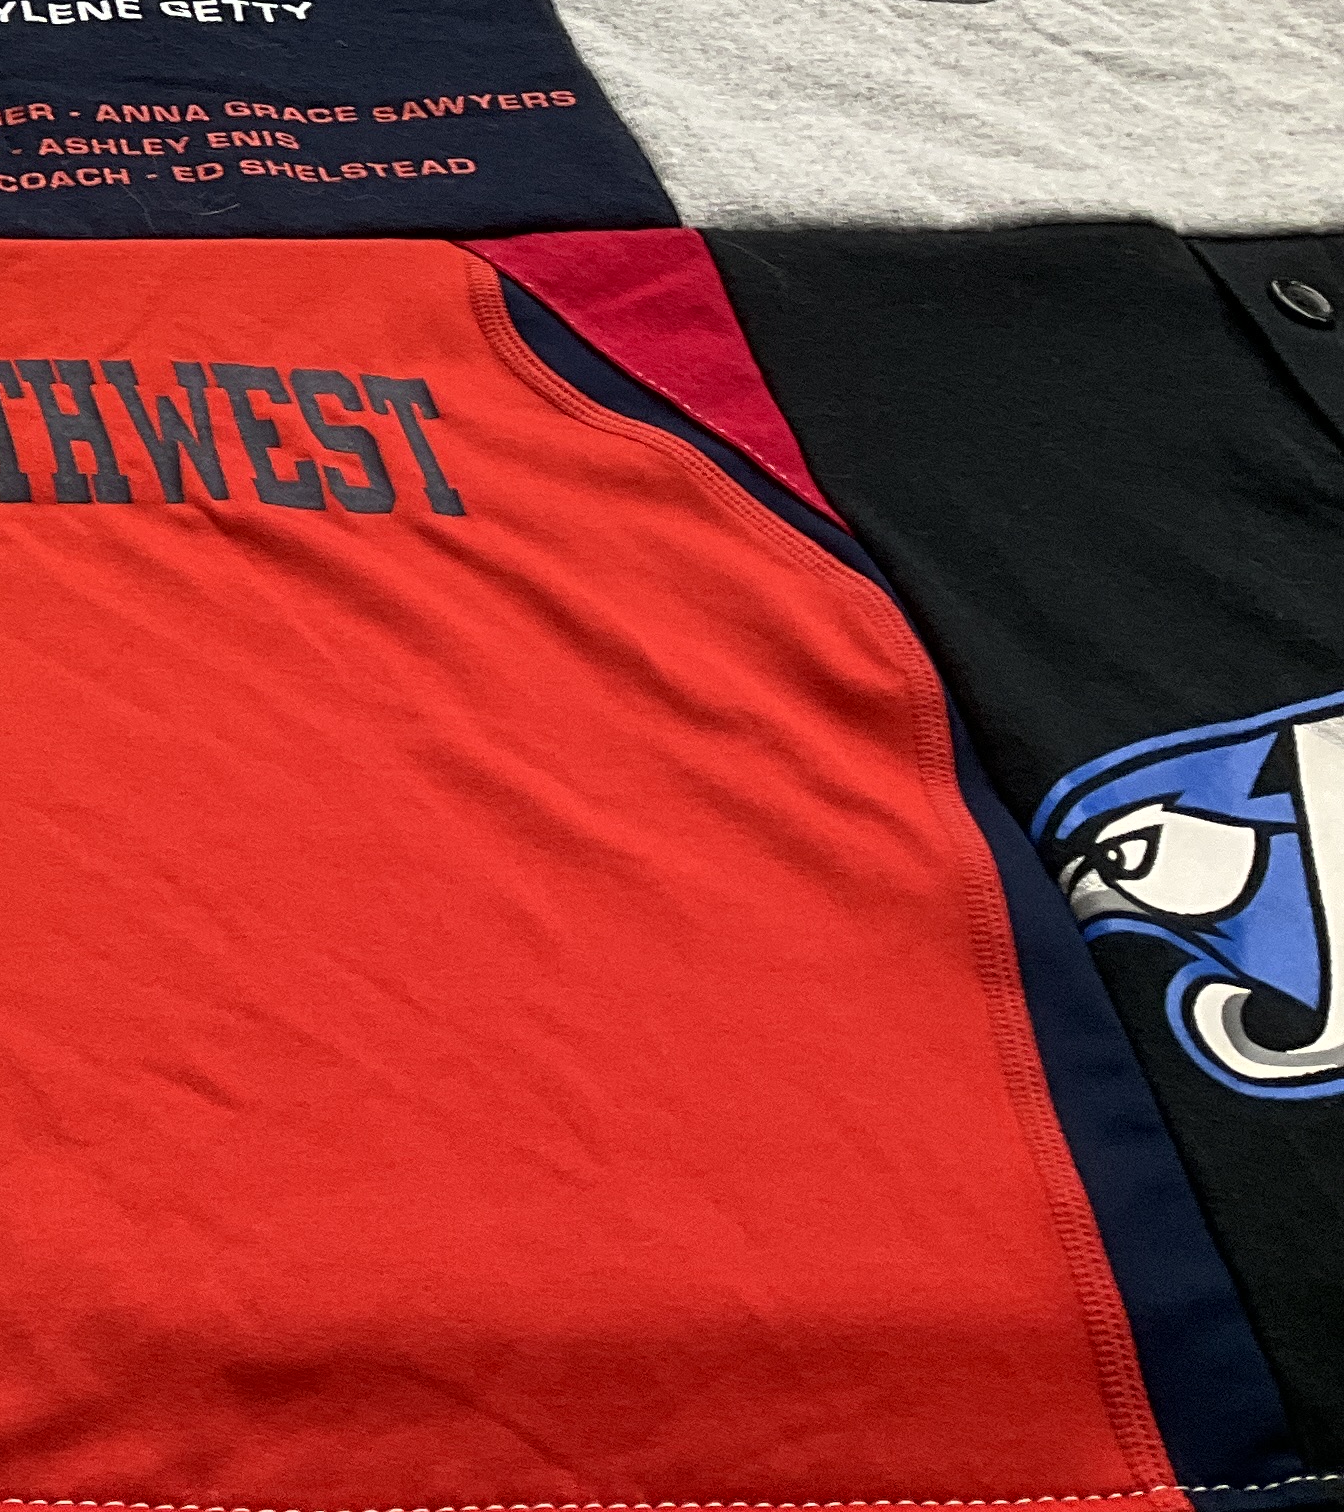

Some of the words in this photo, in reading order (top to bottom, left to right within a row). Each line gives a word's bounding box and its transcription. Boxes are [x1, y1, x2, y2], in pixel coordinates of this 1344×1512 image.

[95, 103, 211, 124] ANNA
[223, 100, 358, 124] GRACE
[371, 89, 577, 124] SAWYERS
[38, 135, 190, 157] ASHLEY
[206, 129, 301, 151] ENIS
[171, 161, 225, 184] ED
[238, 157, 477, 183] SHELSTEAD
